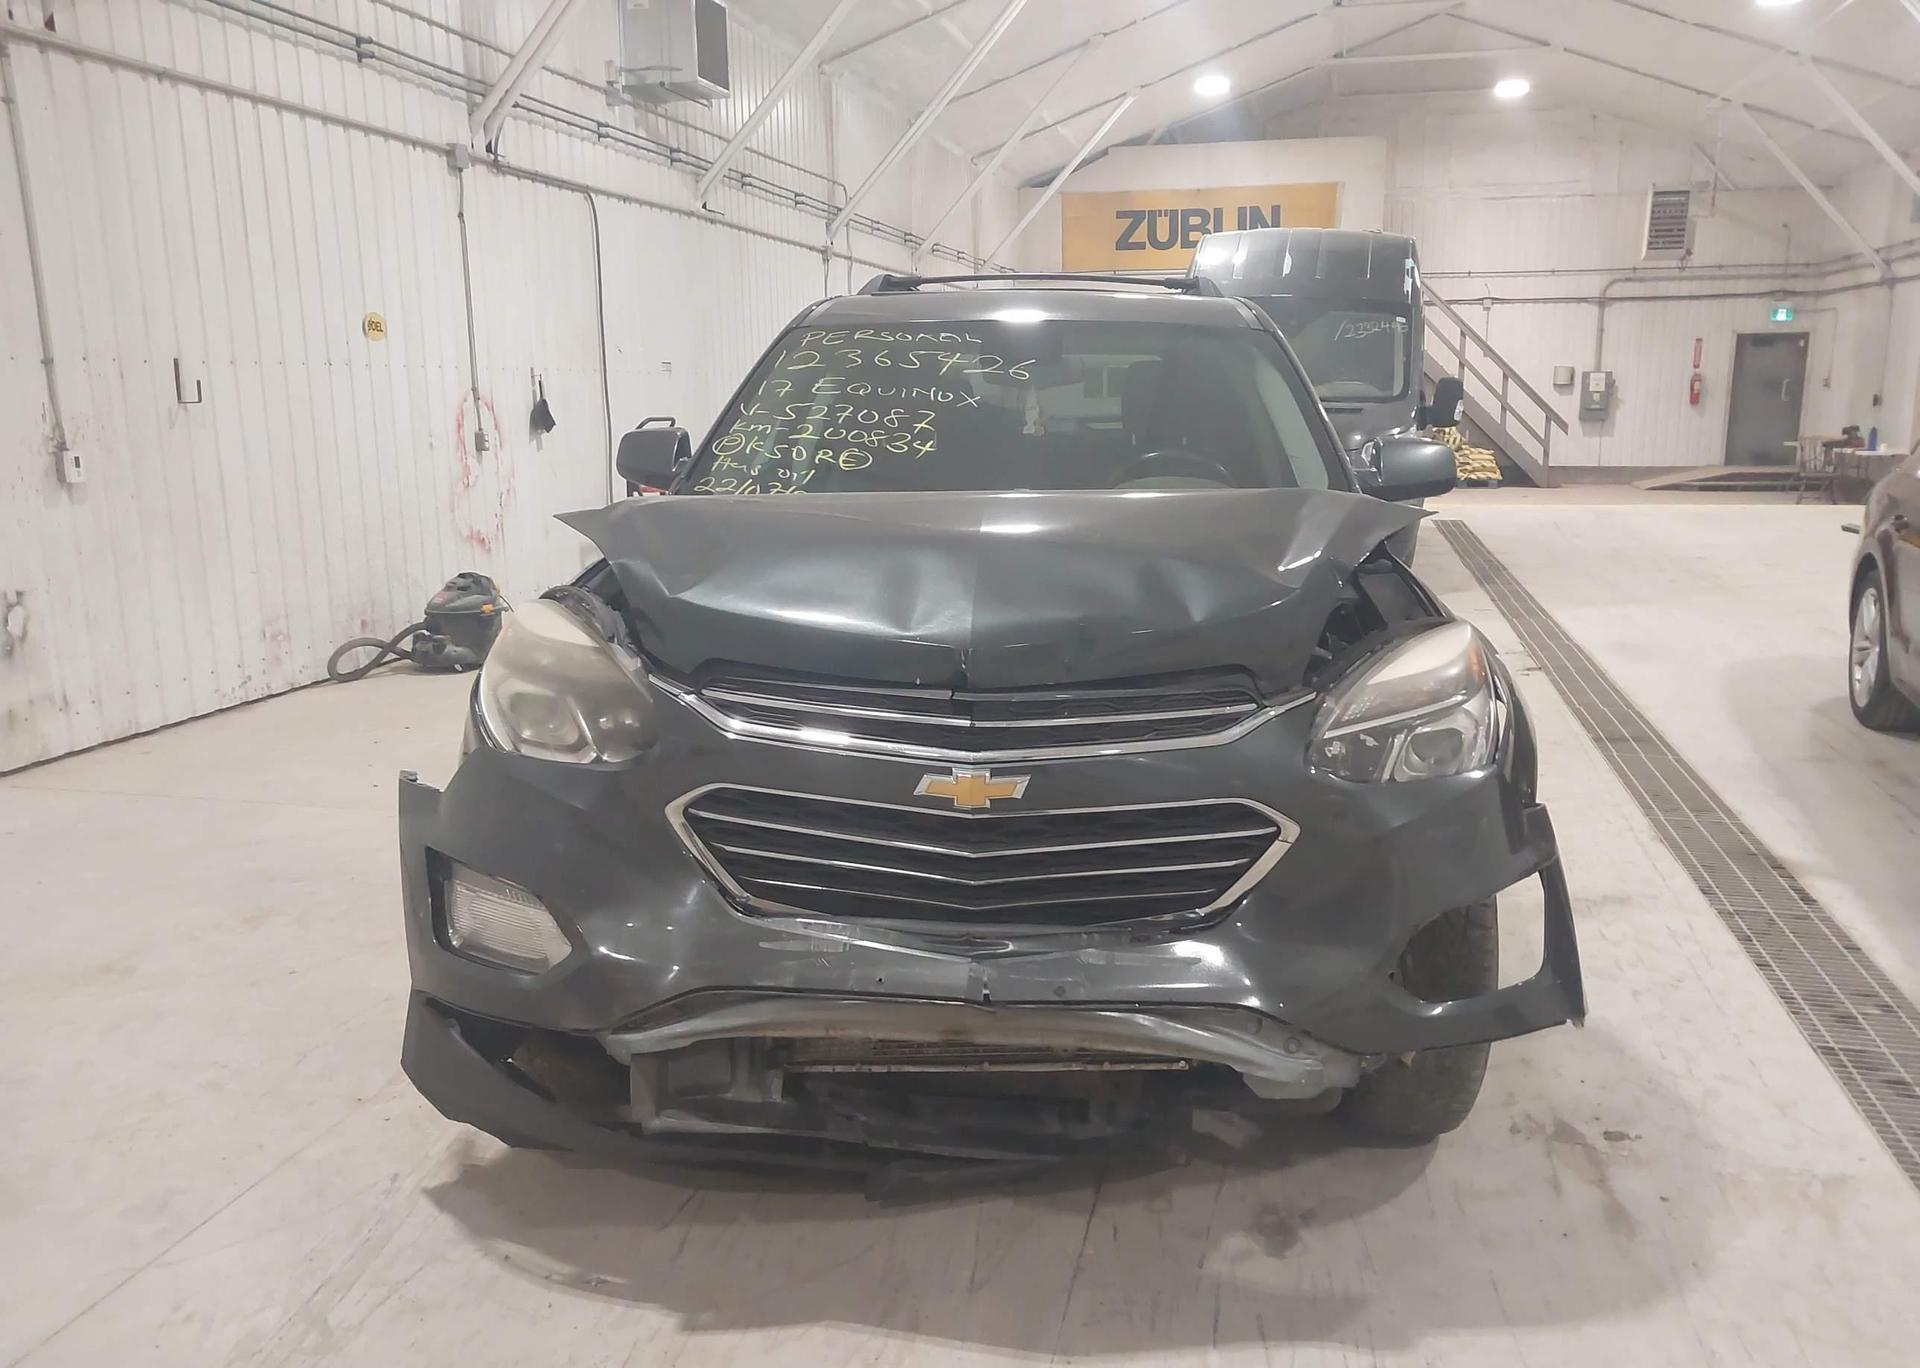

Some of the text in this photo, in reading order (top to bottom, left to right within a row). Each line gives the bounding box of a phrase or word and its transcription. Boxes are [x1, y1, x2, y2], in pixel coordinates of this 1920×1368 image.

[801, 329, 982, 347] PERSONAL
[775, 349, 1036, 380] 12365426
[758, 377, 981, 408] 17 EQUINOX
